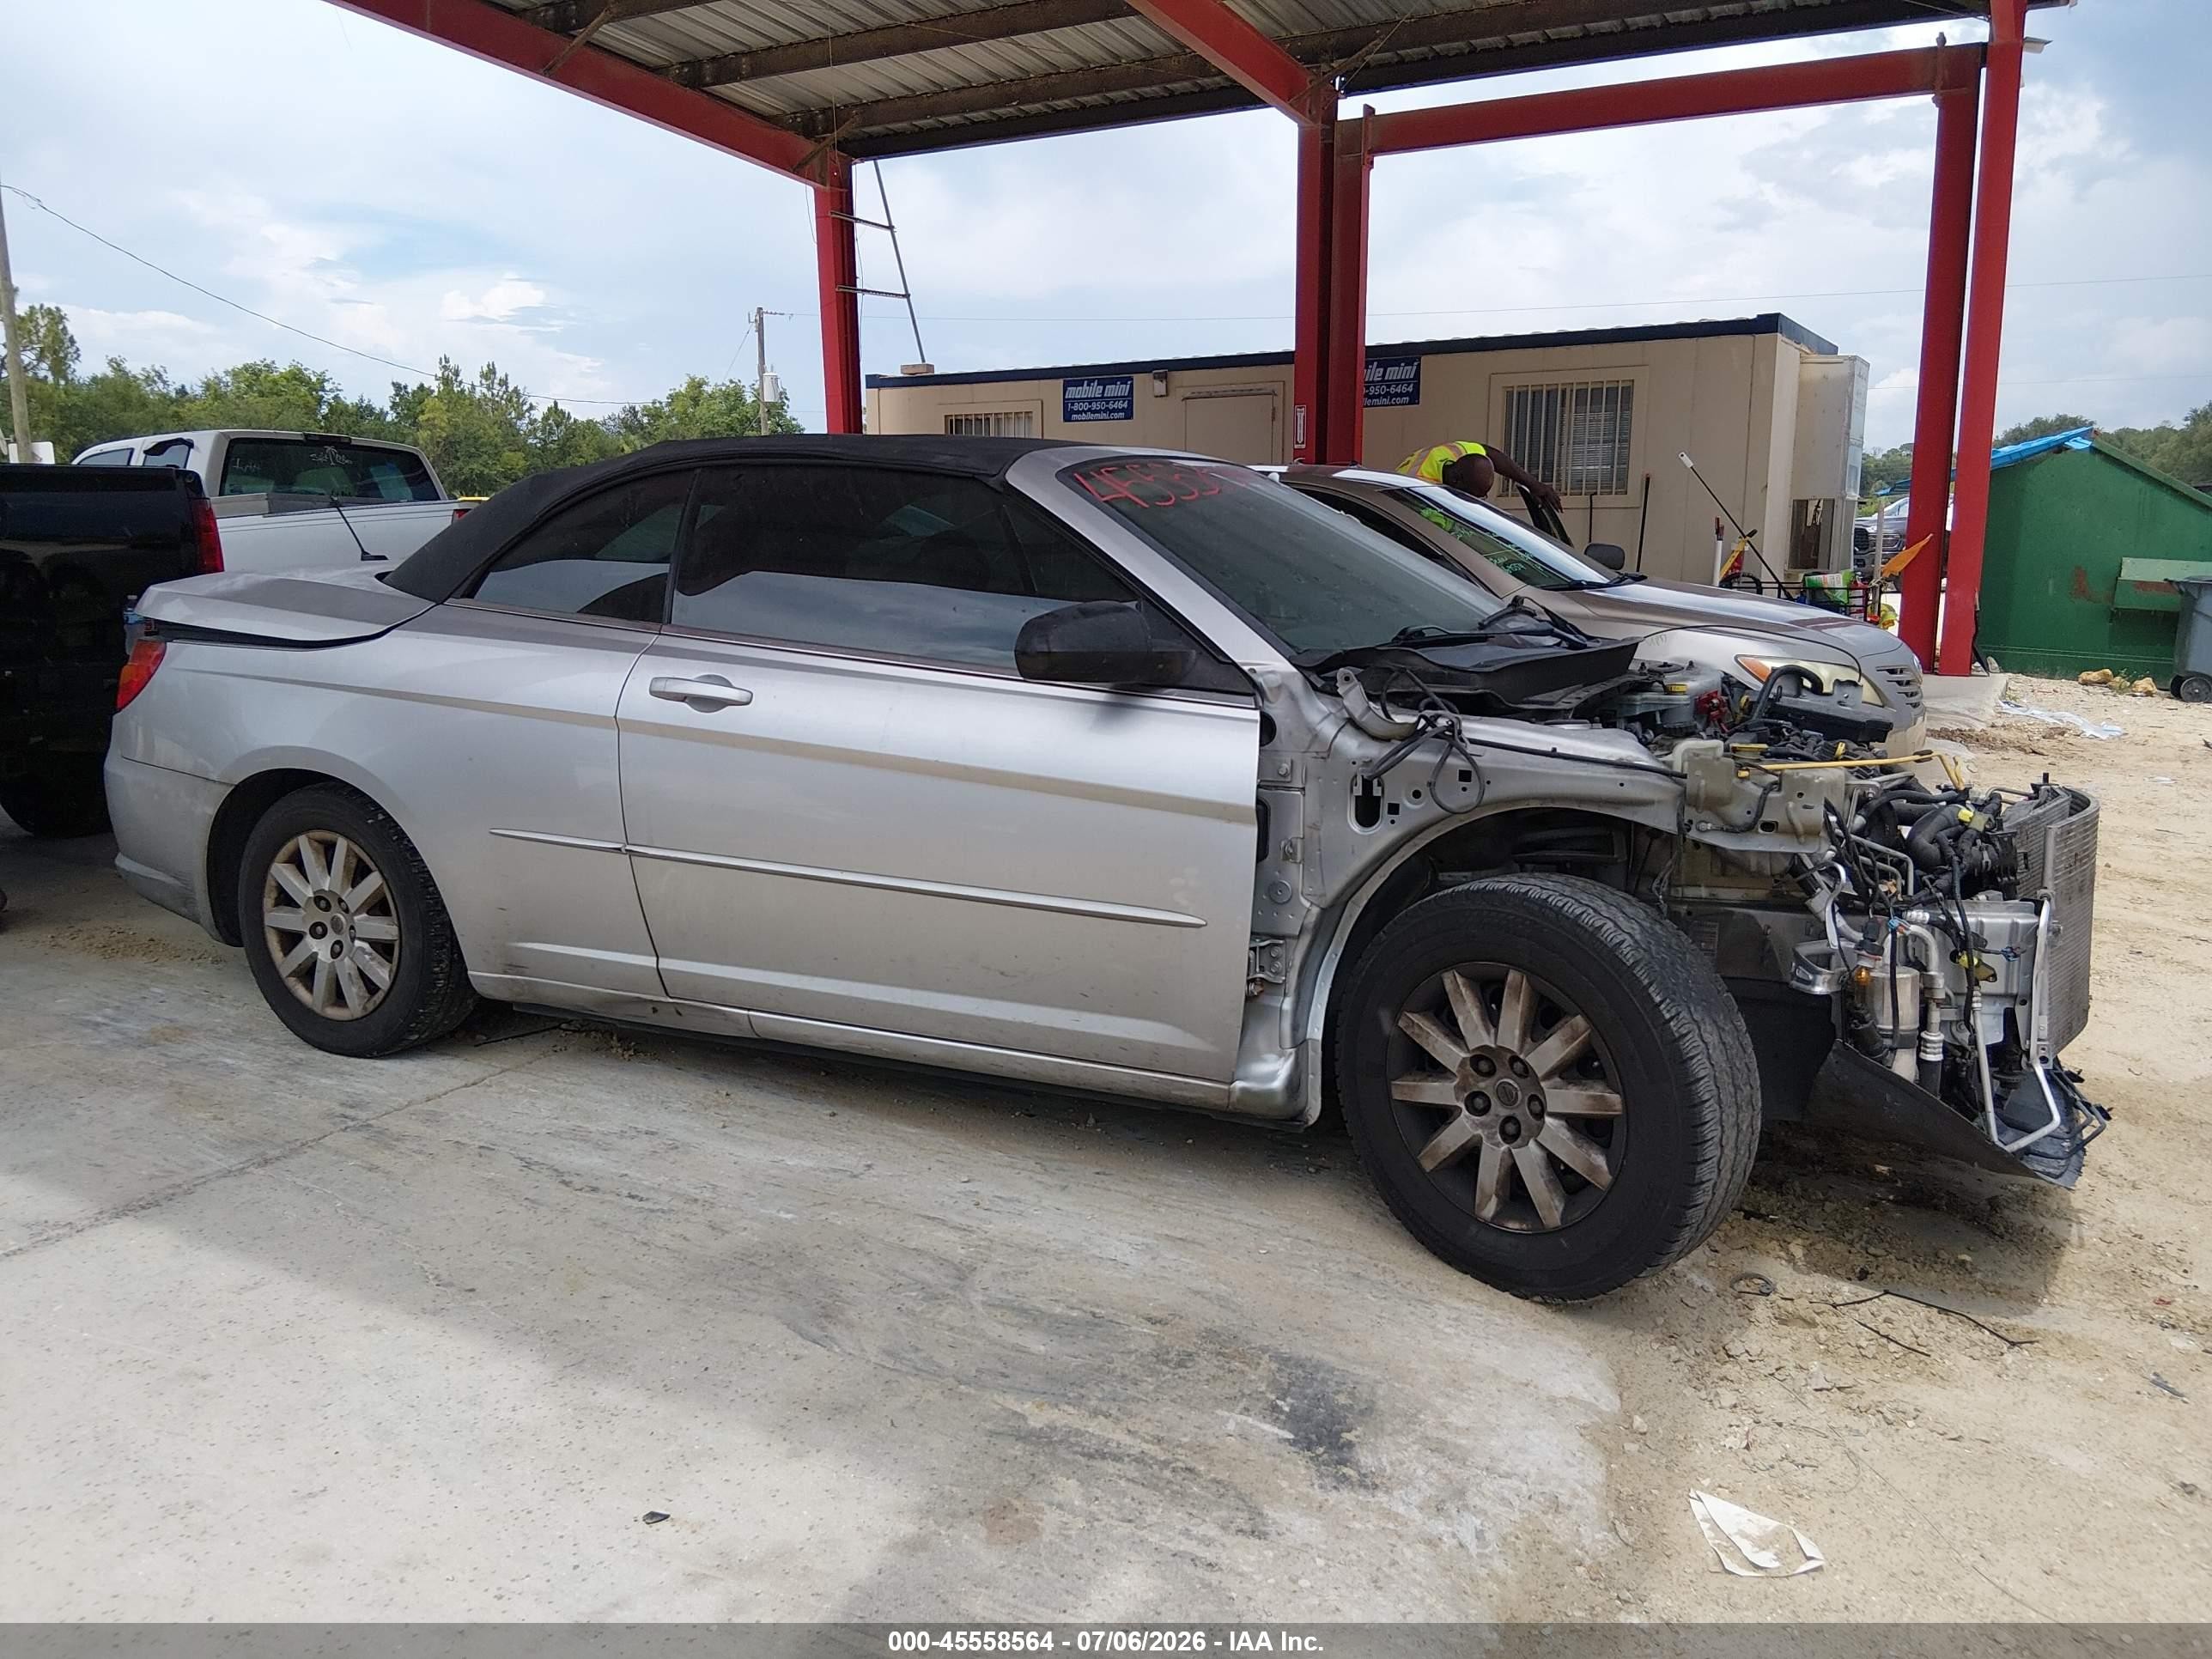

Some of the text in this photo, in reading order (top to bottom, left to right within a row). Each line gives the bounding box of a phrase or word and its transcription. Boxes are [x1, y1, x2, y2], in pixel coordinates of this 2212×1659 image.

[1364, 362, 1419, 381] ile mini
[1065, 380, 1131, 398] mobile mini
[1067, 401, 1127, 411] 1-800-950-6464
[1071, 411, 1125, 421] mobilemini.com
